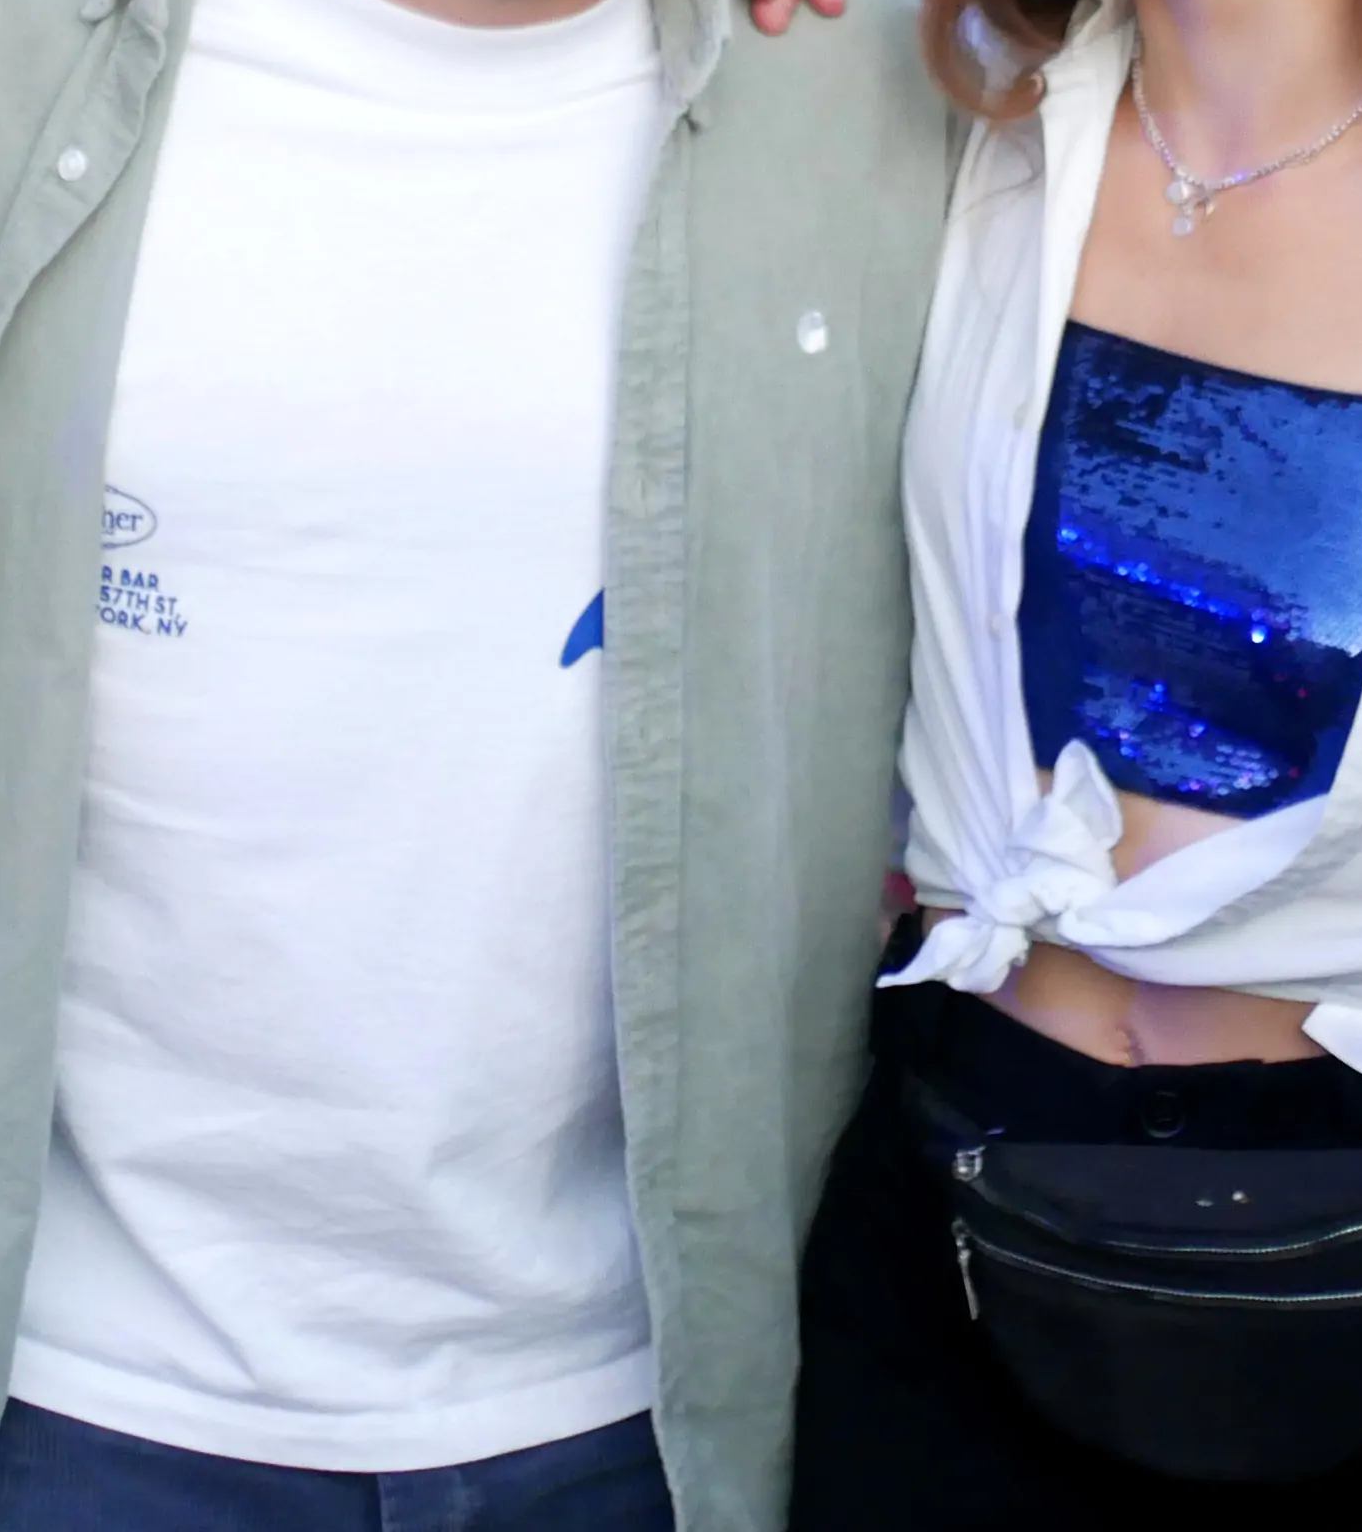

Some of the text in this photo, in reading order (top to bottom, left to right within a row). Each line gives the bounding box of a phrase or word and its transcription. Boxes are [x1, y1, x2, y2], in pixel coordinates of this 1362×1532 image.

[121, 569, 159, 593] BAR
[100, 585, 150, 612] 57TH
[95, 605, 189, 638] ORK, NY
